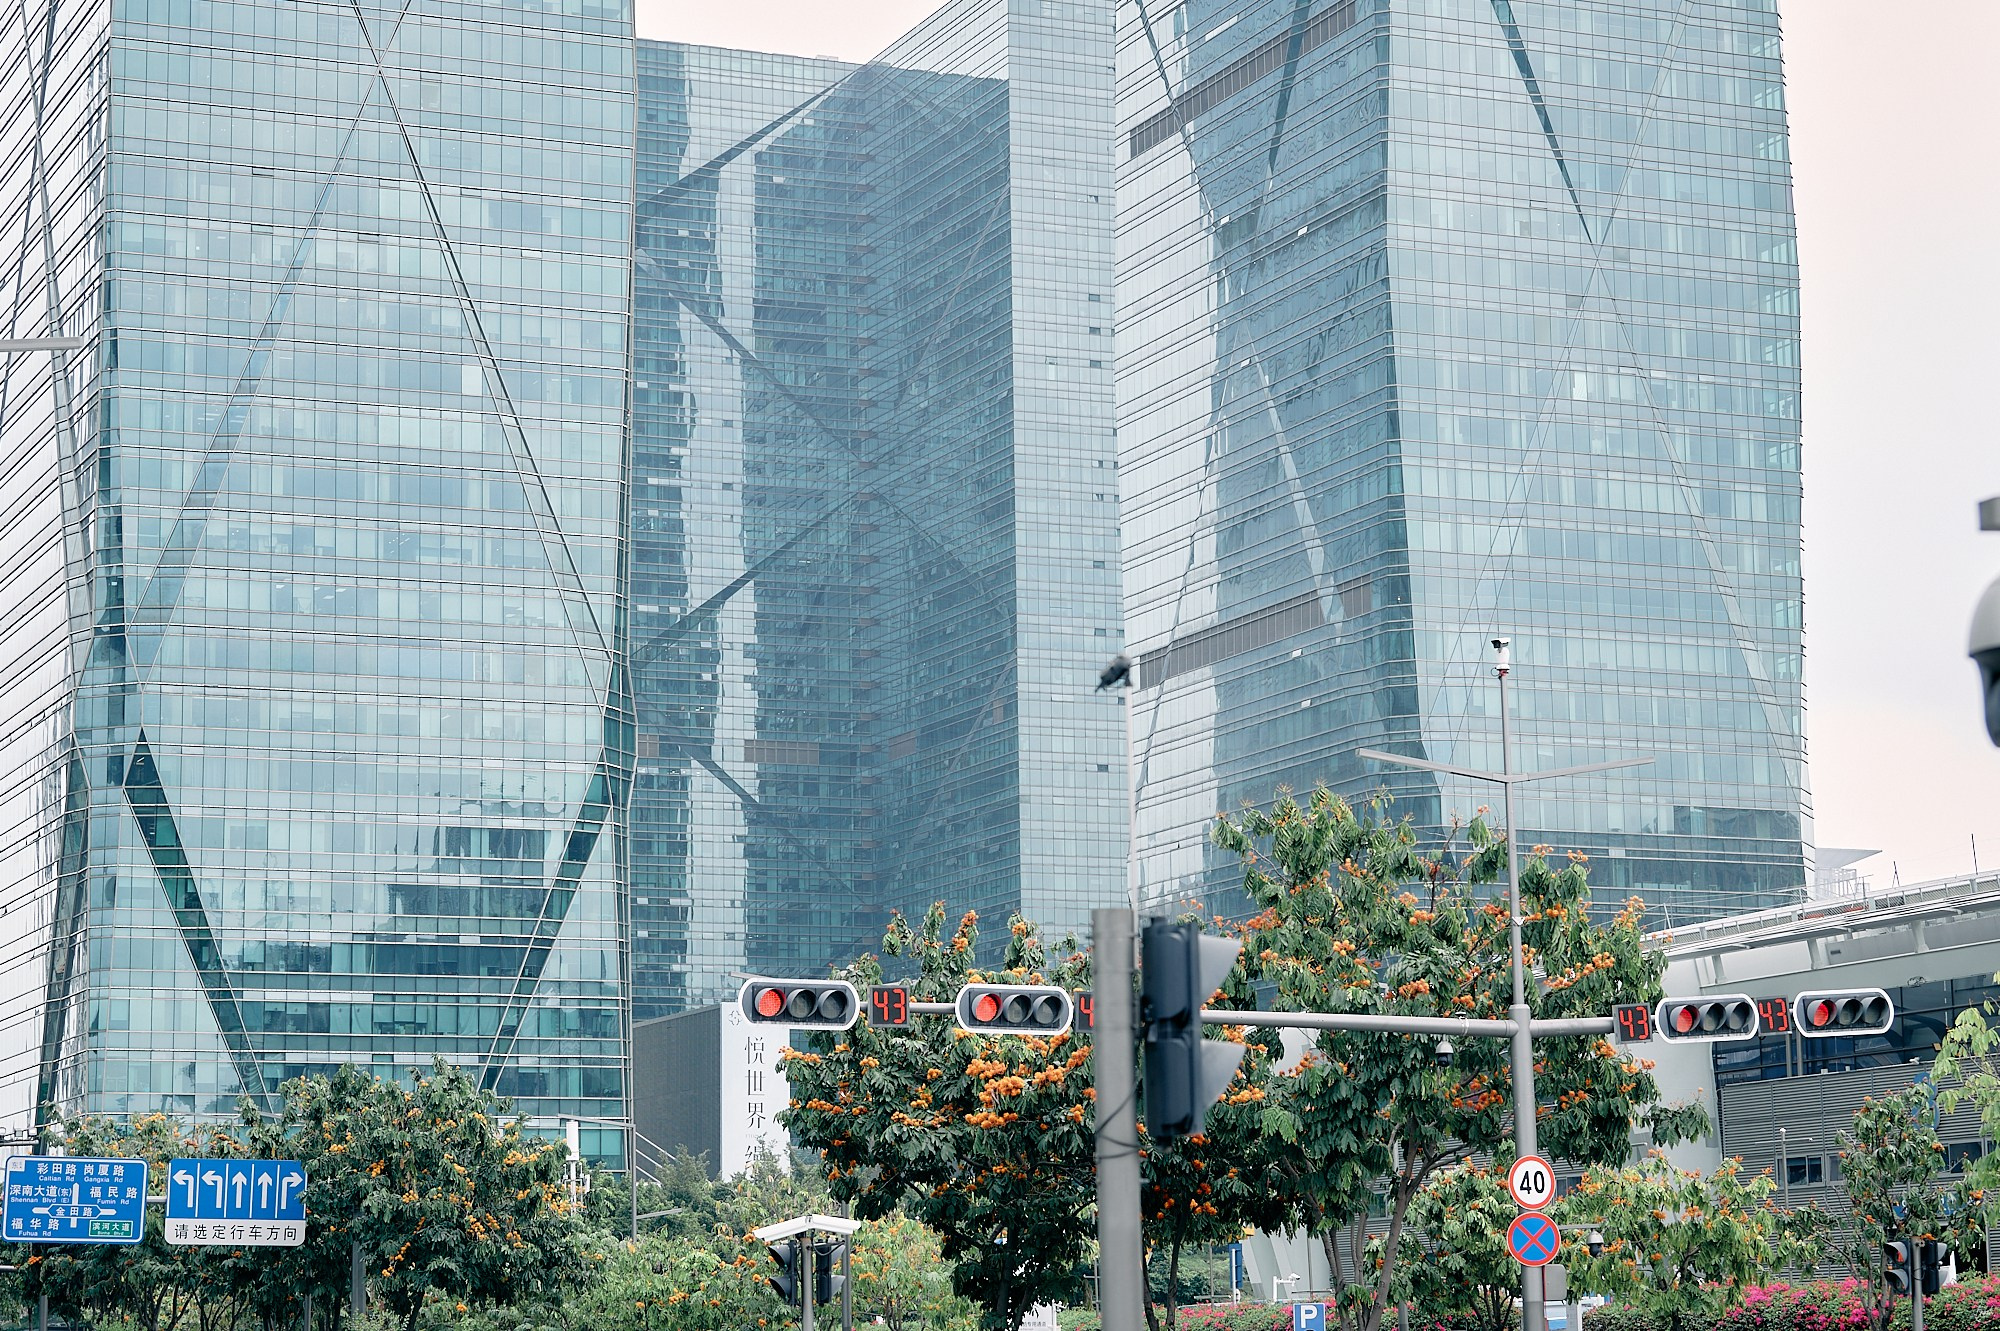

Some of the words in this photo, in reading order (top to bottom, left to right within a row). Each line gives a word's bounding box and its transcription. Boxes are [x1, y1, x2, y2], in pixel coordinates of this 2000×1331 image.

[874, 988, 905, 1024] 43
[1080, 996, 1094, 1027] 4
[1759, 998, 1788, 1031] 43
[1620, 1006, 1648, 1039] 43
[744, 1036, 766, 1129] 悦世界
[37, 1163, 76, 1175] 彩田路
[84, 1164, 124, 1176] 岗厦路
[10, 1185, 72, 1197] 深南大道(东)
[90, 1186, 137, 1198] 福民路
[1520, 1171, 1544, 1194] 40
[56, 1207, 92, 1216] 金田路
[11, 1218, 59, 1230] 福华路
[93, 1222, 130, 1231] 滨河大道
[175, 1224, 297, 1241] 请选定行车方向
[1301, 1305, 1317, 1328] P
